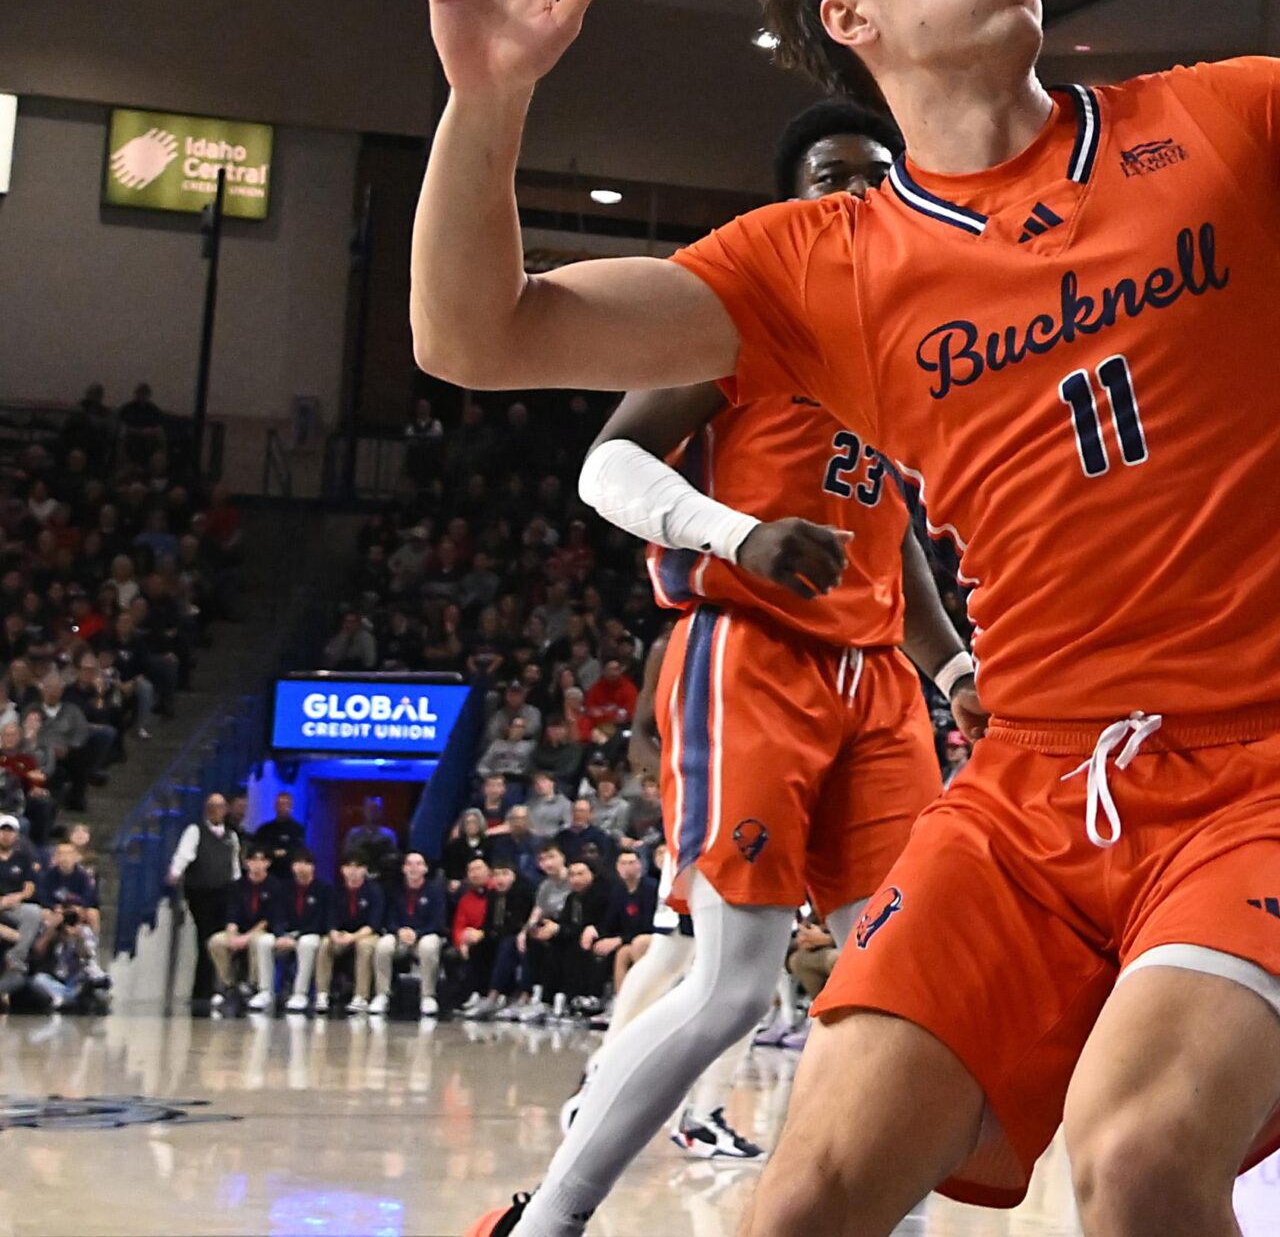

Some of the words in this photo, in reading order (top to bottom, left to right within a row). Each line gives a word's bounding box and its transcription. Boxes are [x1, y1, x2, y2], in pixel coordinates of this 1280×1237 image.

[185, 136, 247, 162] Idaho
[183, 157, 268, 184] Central
[917, 222, 1230, 400] Bucknell
[1059, 354, 1149, 478] 11
[822, 431, 886, 507] 23
[303, 693, 438, 722] GLOBAL
[302, 721, 371, 738] CREDIT
[374, 724, 436, 740] UNION
